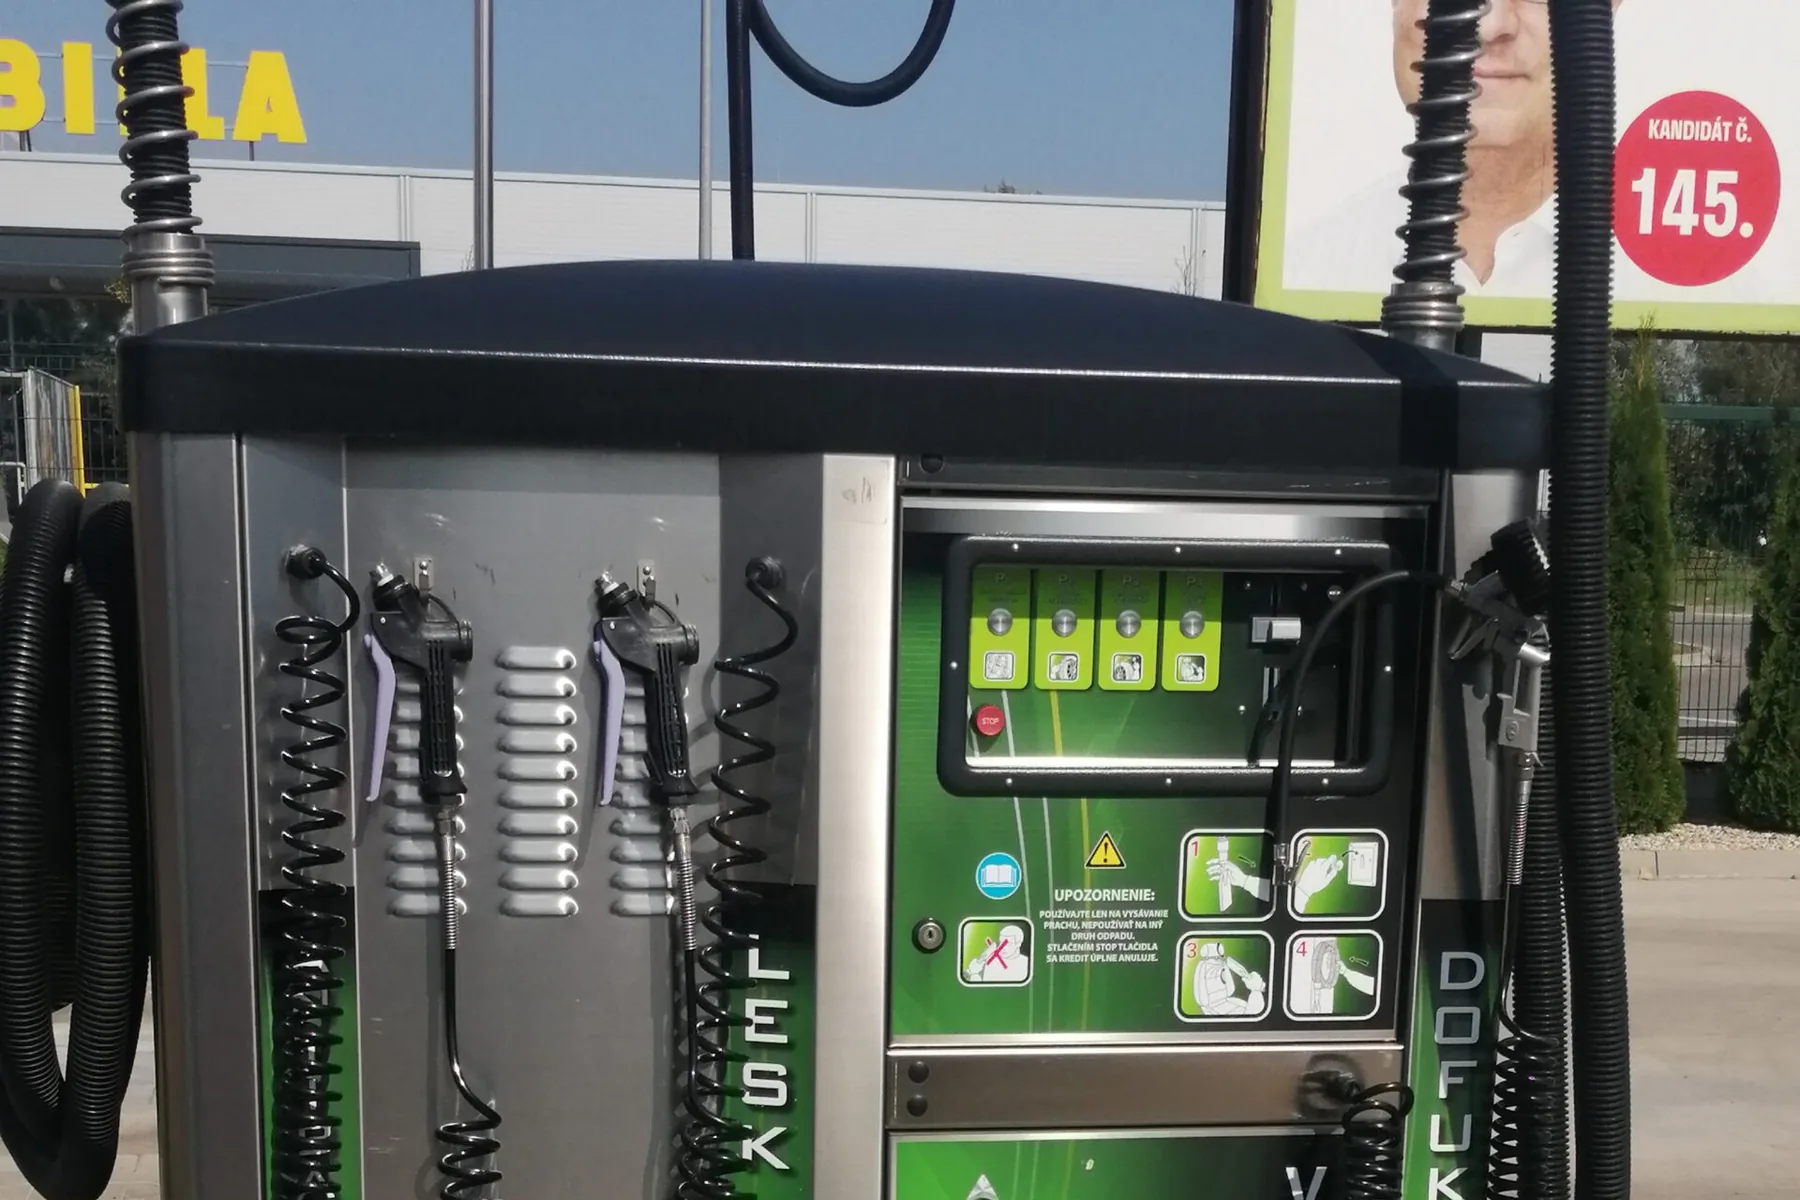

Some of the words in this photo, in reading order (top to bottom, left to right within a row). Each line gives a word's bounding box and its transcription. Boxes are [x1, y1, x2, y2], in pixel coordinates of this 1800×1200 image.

[0, 38, 307, 143] BILA
[1648, 116, 1732, 142] KANDIDÁT
[1735, 116, 1752, 143] Č.
[1631, 167, 1754, 238] 145.
[981, 717, 1000, 725] STOP
[1191, 841, 1199, 857] 1
[1054, 888, 1155, 902] UPOZORNENIE:
[1039, 908, 1091, 919] POUŽÍVAJTE
[1091, 909, 1107, 918] LEN
[1108, 909, 1121, 918] NA
[1122, 908, 1169, 918] VYSÁVANIE
[1043, 921, 1080, 931] PRACHU,
[1135, 920, 1147, 929] NA
[1148, 919, 1164, 929] INÝ
[1071, 932, 1096, 941] DRUH
[1096, 931, 1135, 941] ODPADU.
[1047, 942, 1095, 953] STLAČENÍM
[1095, 943, 1117, 952] STOP
[1118, 942, 1158, 952] TLAČIDLA
[1187, 942, 1197, 959] 3
[1295, 941, 1308, 957] 4
[1046, 954, 1058, 963] SA
[1059, 953, 1089, 963] KREDIT
[1090, 952, 1118, 963] ÚPLNE
[1118, 953, 1159, 963] ANULUJE.
[741, 934, 790, 1169] LESK
